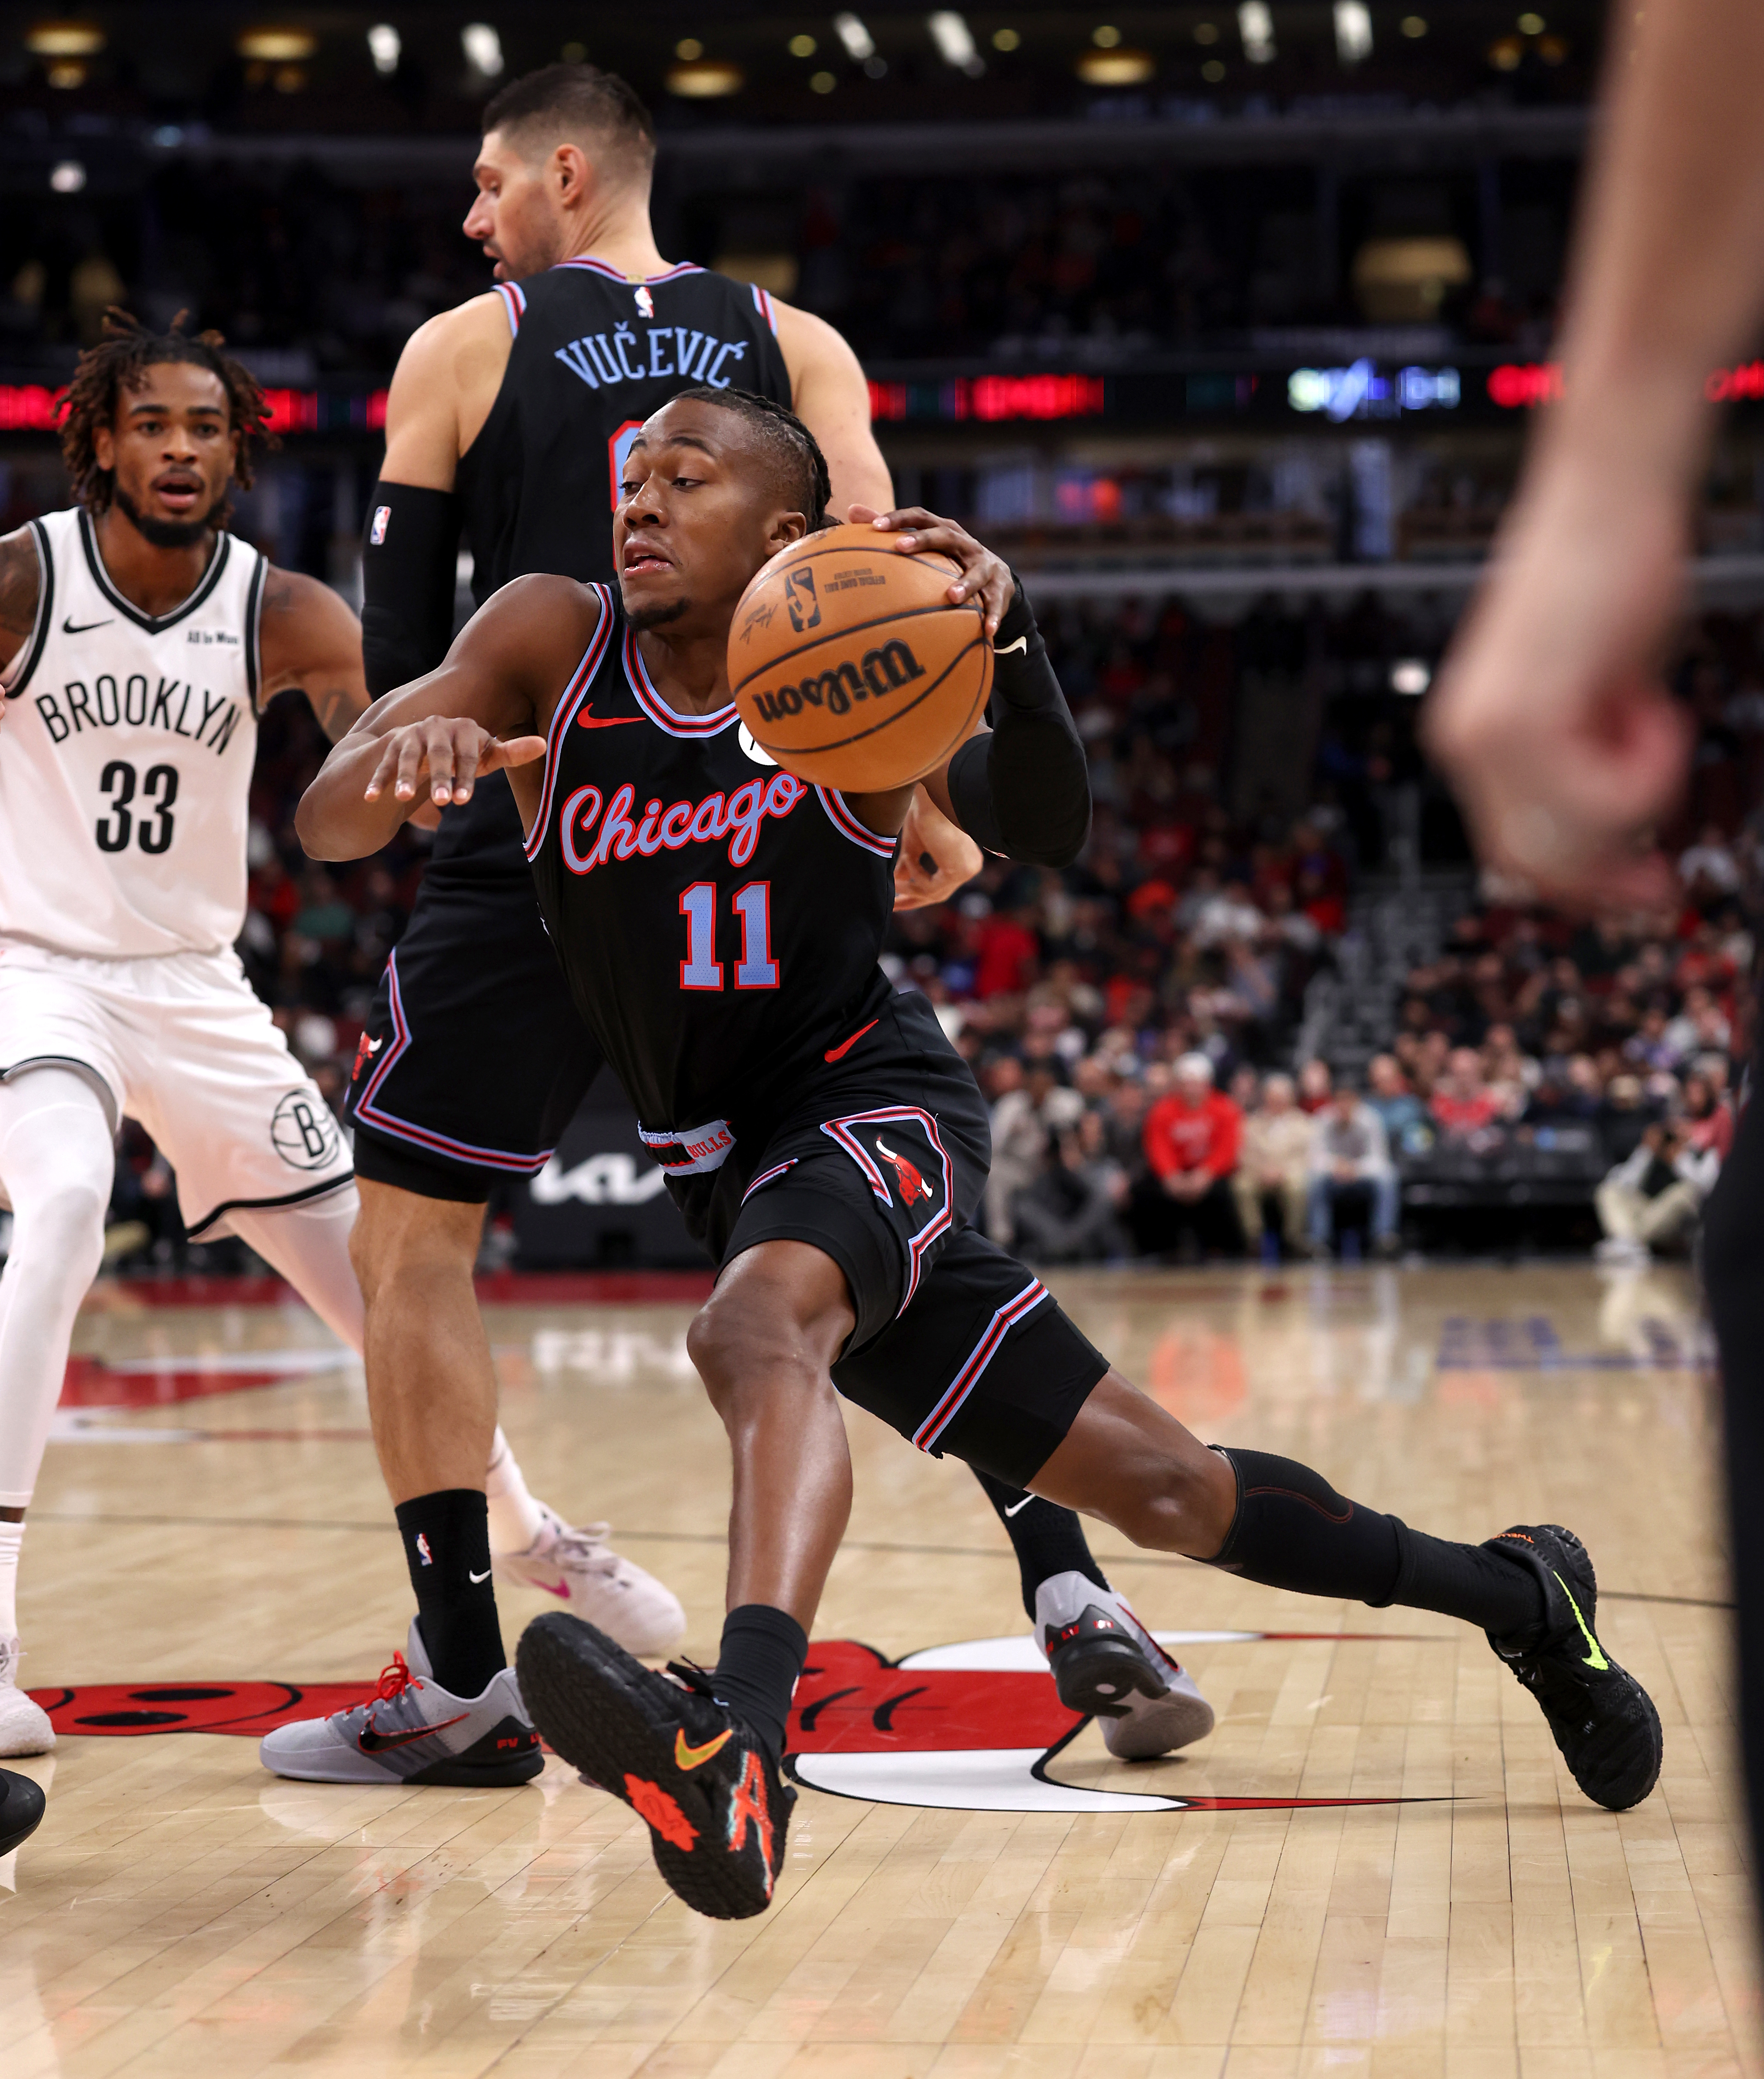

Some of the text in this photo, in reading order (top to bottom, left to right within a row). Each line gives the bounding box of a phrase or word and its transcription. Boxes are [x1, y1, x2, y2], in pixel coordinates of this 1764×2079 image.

[554, 321, 749, 390] VUČEVIĆ
[35, 674, 242, 756] BROOKLYN
[752, 638, 926, 722] Wilson
[95, 760, 179, 855] 33
[560, 770, 808, 876] Chicago
[679, 881, 780, 992] 11
[686, 1130, 732, 1158] BULLS
